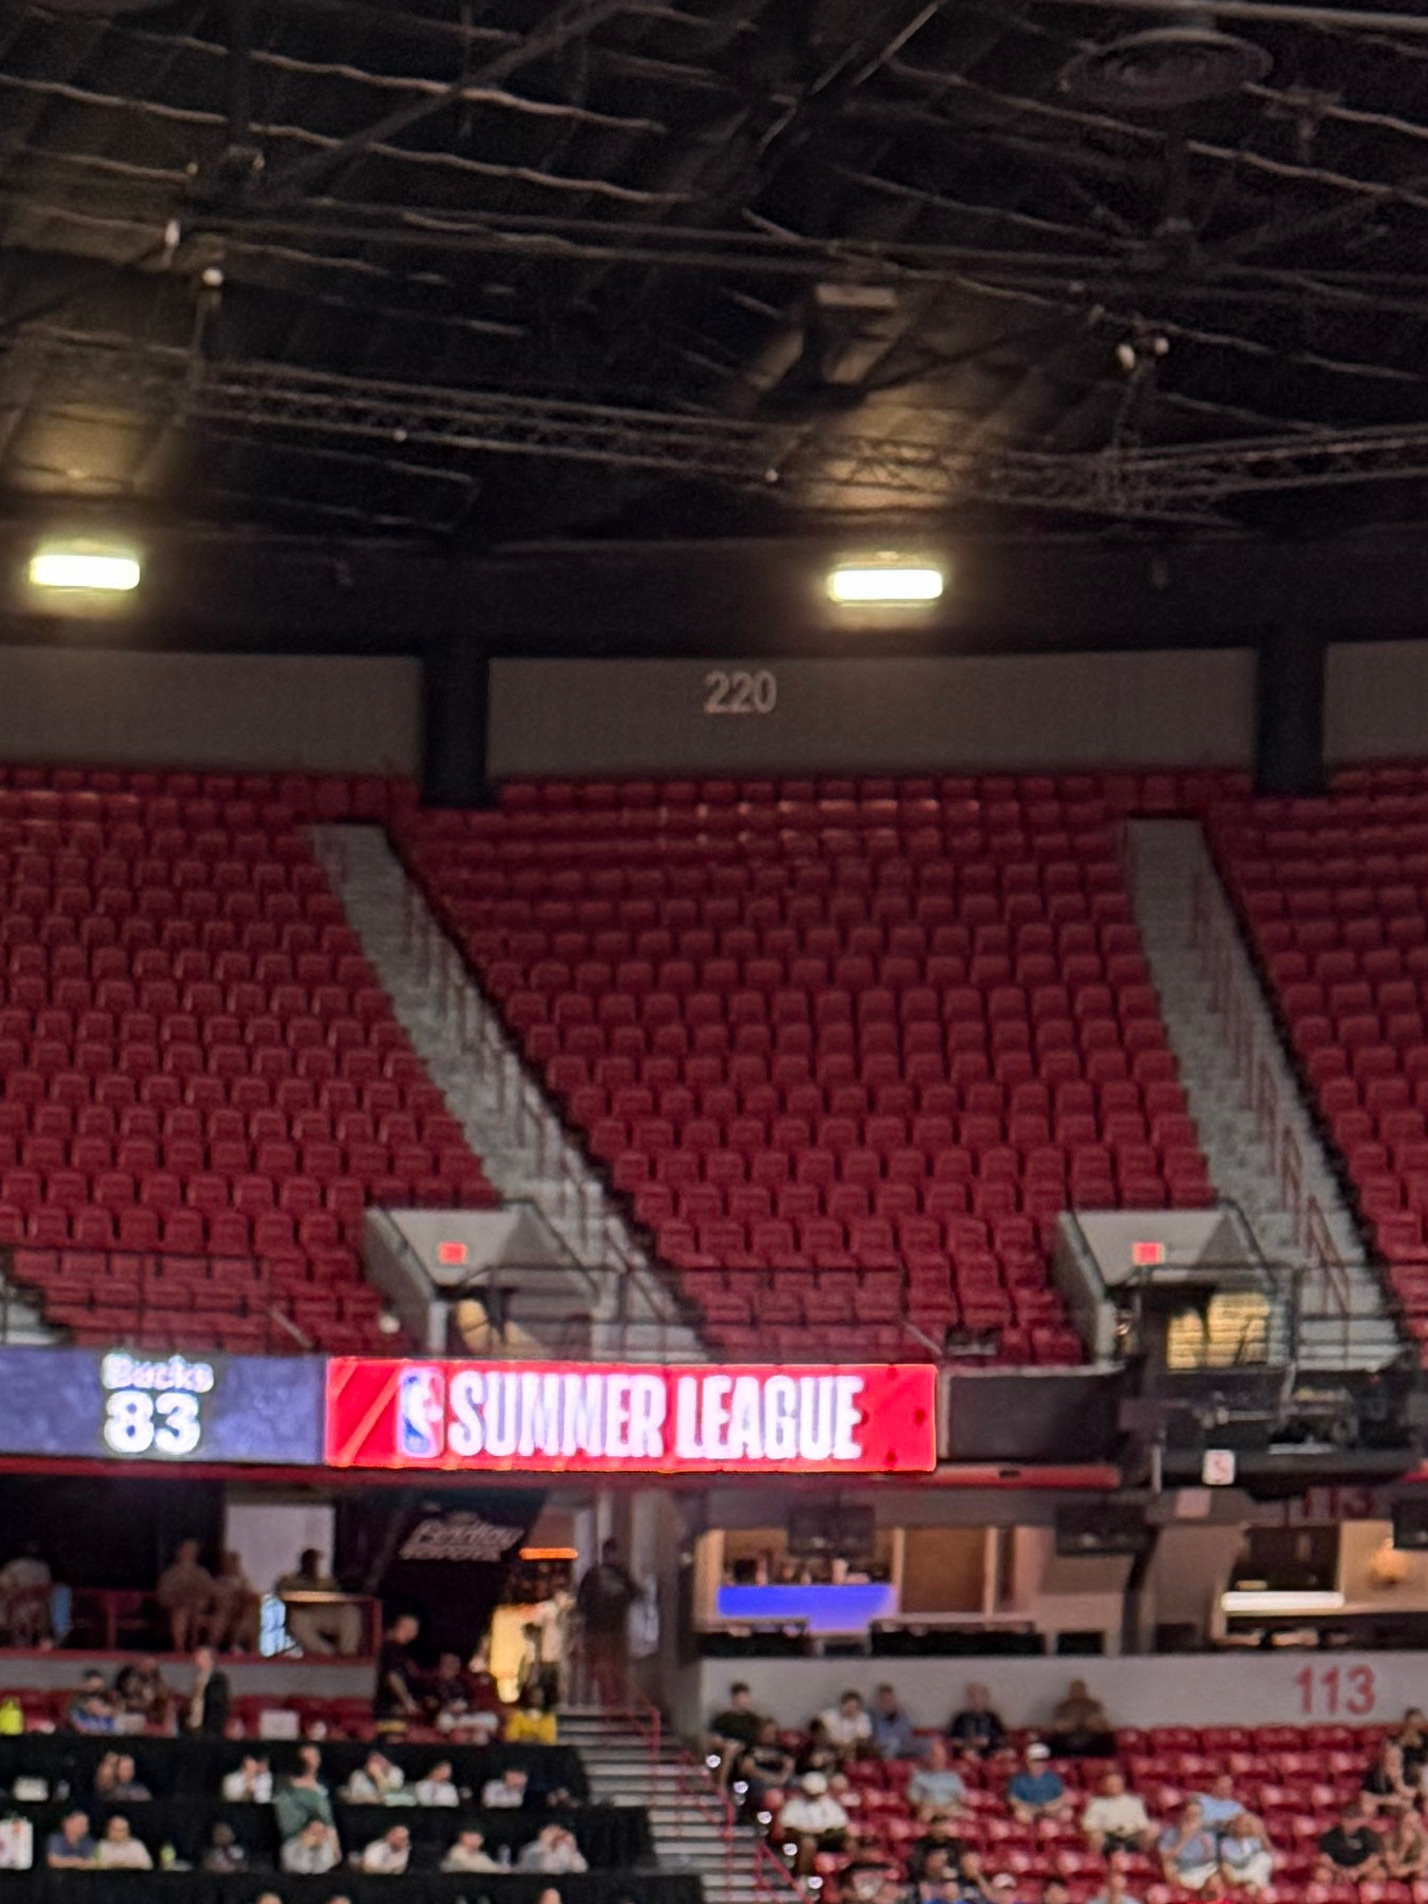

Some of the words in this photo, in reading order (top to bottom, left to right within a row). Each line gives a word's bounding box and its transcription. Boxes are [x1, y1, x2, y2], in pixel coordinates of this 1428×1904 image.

[704, 670, 777, 714] 220
[103, 1389, 201, 1456] 83
[447, 1370, 668, 1460] SUMMER
[675, 1374, 864, 1460] LEAGUE
[1293, 1663, 1377, 1717] 113
